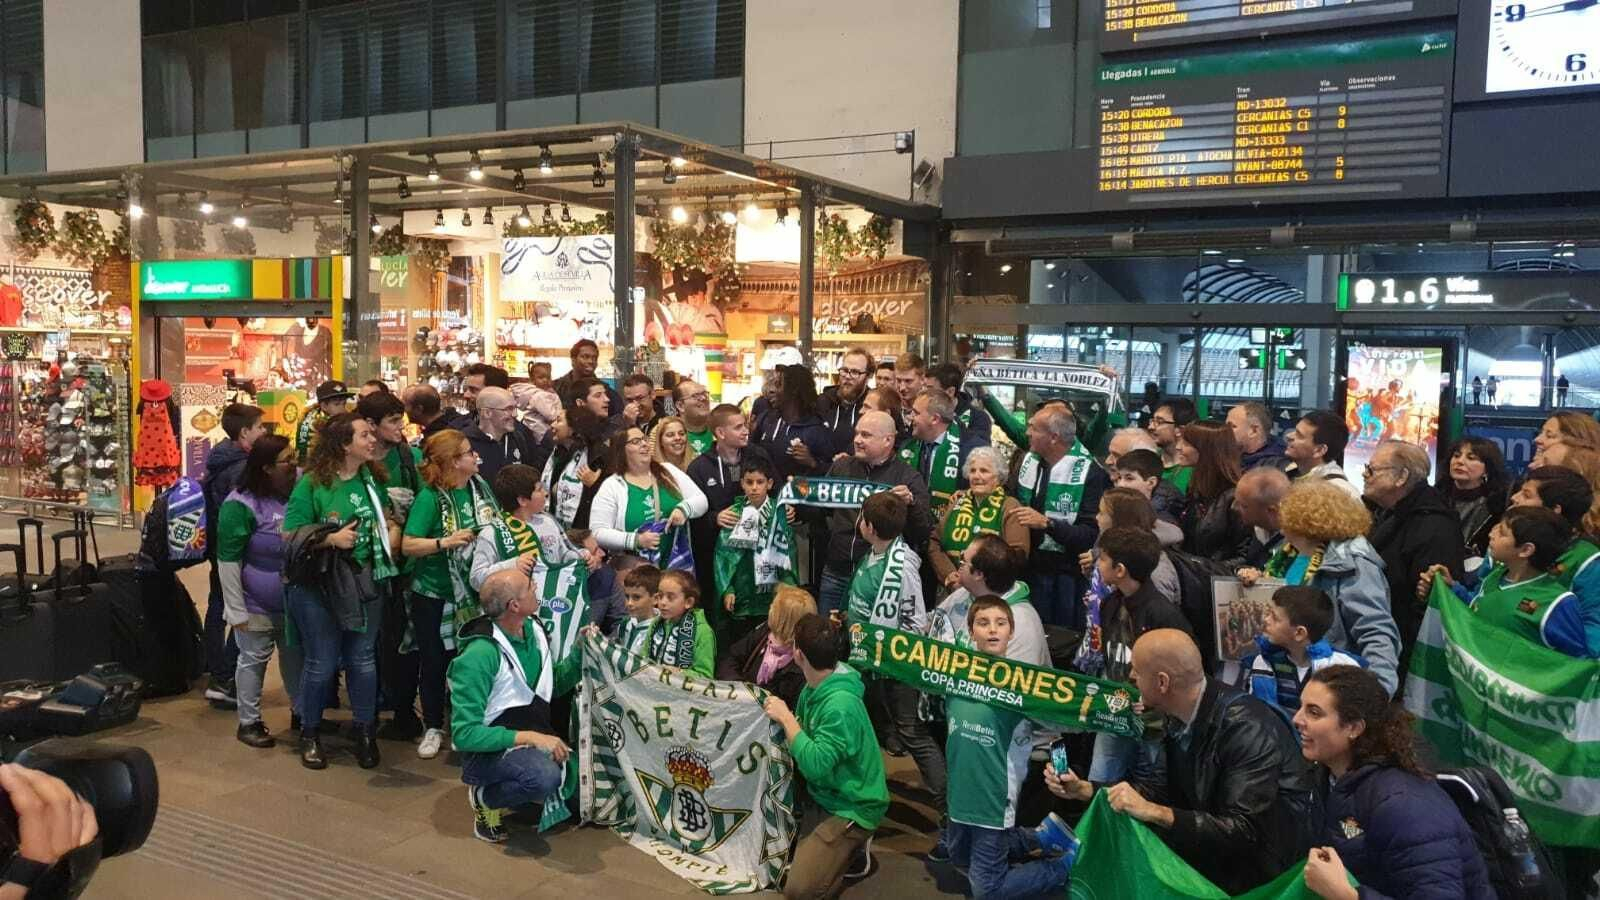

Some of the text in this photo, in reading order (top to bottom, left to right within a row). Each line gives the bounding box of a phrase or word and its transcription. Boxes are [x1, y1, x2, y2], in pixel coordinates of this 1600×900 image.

[1135, 13, 1188, 28] BENACAZON
[1505, 4, 1525, 22] 9
[1565, 53, 1586, 72] 6
[1101, 69, 1142, 80] Llegadas
[1348, 75, 1395, 84] Observaciones
[1102, 110, 1129, 121] 15:20
[1131, 106, 1171, 118] CORDOBA
[1131, 118, 1183, 130] BENACAZON
[1236, 110, 1292, 122] CERCANIAS
[1297, 108, 1311, 118] C5
[1338, 105, 1346, 116] 9
[1130, 130, 1165, 142] UTRERA
[1236, 122, 1292, 135] CERCANIAS
[1296, 121, 1309, 132] C1
[1130, 143, 1160, 154] CADIZ
[1130, 154, 1164, 165] MADRID
[1130, 166, 1163, 178] MALAGA
[1336, 156, 1344, 167] 5
[1128, 177, 1174, 189] JARDINES
[1179, 176, 1189, 186] DE
[1234, 172, 1289, 184] CERCANIAS
[1295, 171, 1308, 181] C5
[21, 283, 112, 307] scover
[1381, 278, 1399, 303] 1
[1420, 277, 1439, 303] 6
[821, 297, 915, 317] discover
[890, 635, 1077, 704] CAMPEONES
[921, 669, 955, 689] COPA
[957, 679, 1023, 707] PRINCESA
[626, 706, 767, 775] BETIS
